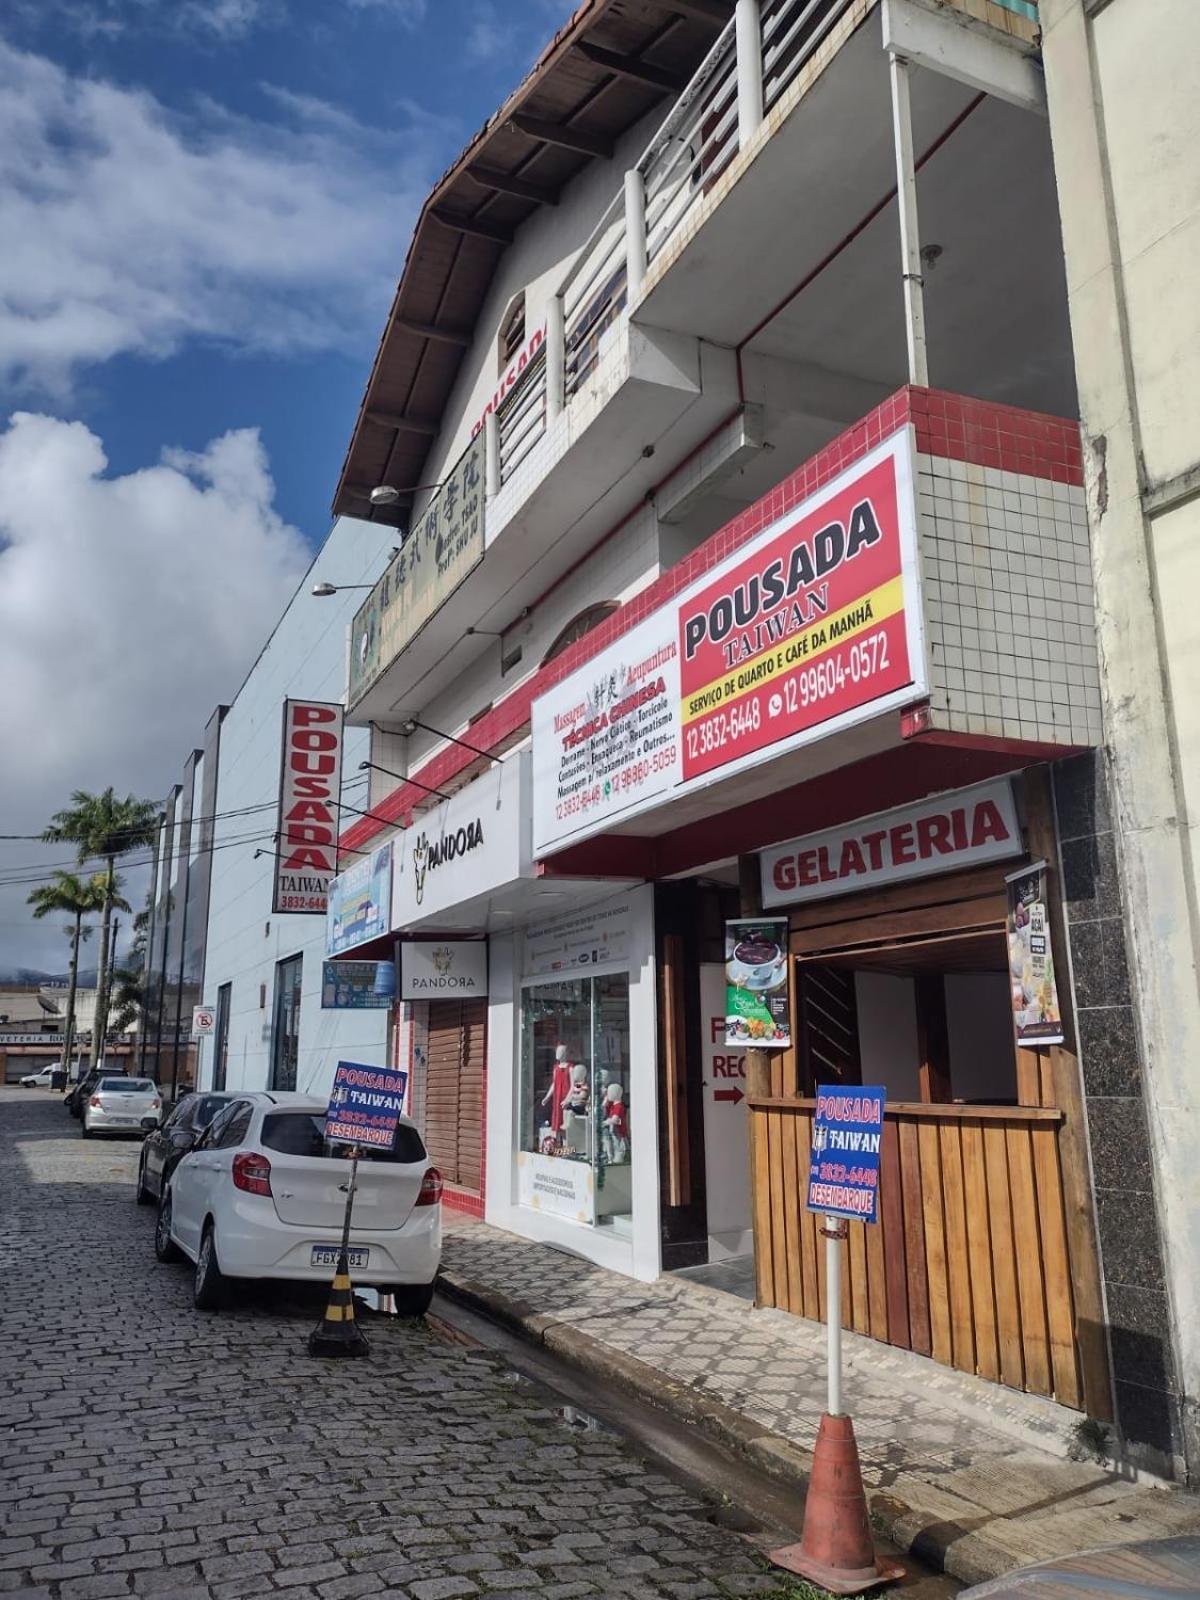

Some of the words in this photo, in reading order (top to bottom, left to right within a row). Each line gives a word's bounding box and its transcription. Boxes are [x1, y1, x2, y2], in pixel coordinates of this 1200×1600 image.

[685, 498, 883, 661] POUSADA
[723, 583, 829, 670] TAIWAN
[626, 640, 677, 687] Acupuntura
[689, 687, 723, 716] SERVIÇO
[725, 679, 736, 697] DE
[737, 659, 775, 690] QUARTO
[777, 652, 784, 669] E
[785, 634, 809, 664] CAFÉ
[811, 628, 827, 651] DA
[829, 600, 874, 641] MANHÃ
[609, 675, 667, 723] CHINESA
[687, 727, 699, 760] 12
[699, 696, 762, 755] 3832-6448
[783, 677, 799, 715] 12
[800, 630, 890, 708] 99604-0572
[590, 734, 609, 751] Nervo
[638, 696, 668, 723] Torcicolo
[629, 711, 673, 743] Reumatismo
[595, 749, 635, 778] relaxamento
[282, 705, 339, 870] POUSADA
[427, 817, 484, 872] PANDORA
[772, 799, 1011, 892] GELATERIA
[411, 976, 476, 989] PANDORA
[335, 1067, 404, 1094] POUSADA
[350, 1090, 402, 1111] TAIWAN
[325, 1121, 395, 1146] DESEMBARQUE
[816, 1095, 881, 1125] POUSADA
[829, 1129, 881, 1154] TAIWAN
[808, 1182, 874, 1215] DESEMBARQUE
